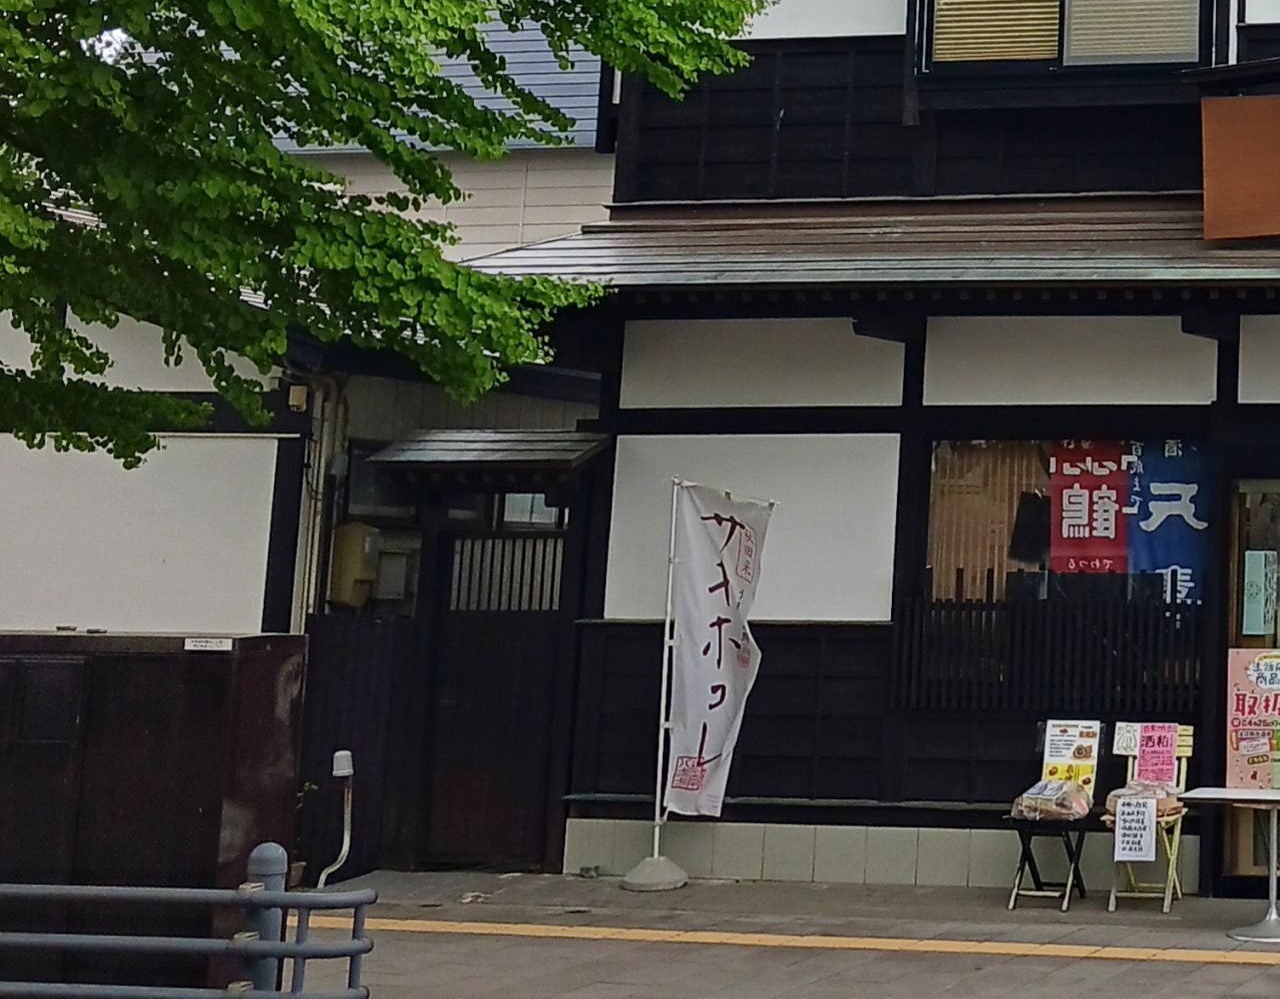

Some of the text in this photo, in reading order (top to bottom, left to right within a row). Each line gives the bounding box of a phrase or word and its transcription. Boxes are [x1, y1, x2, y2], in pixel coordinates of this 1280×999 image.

[697, 512, 745, 768] サキホコレ
